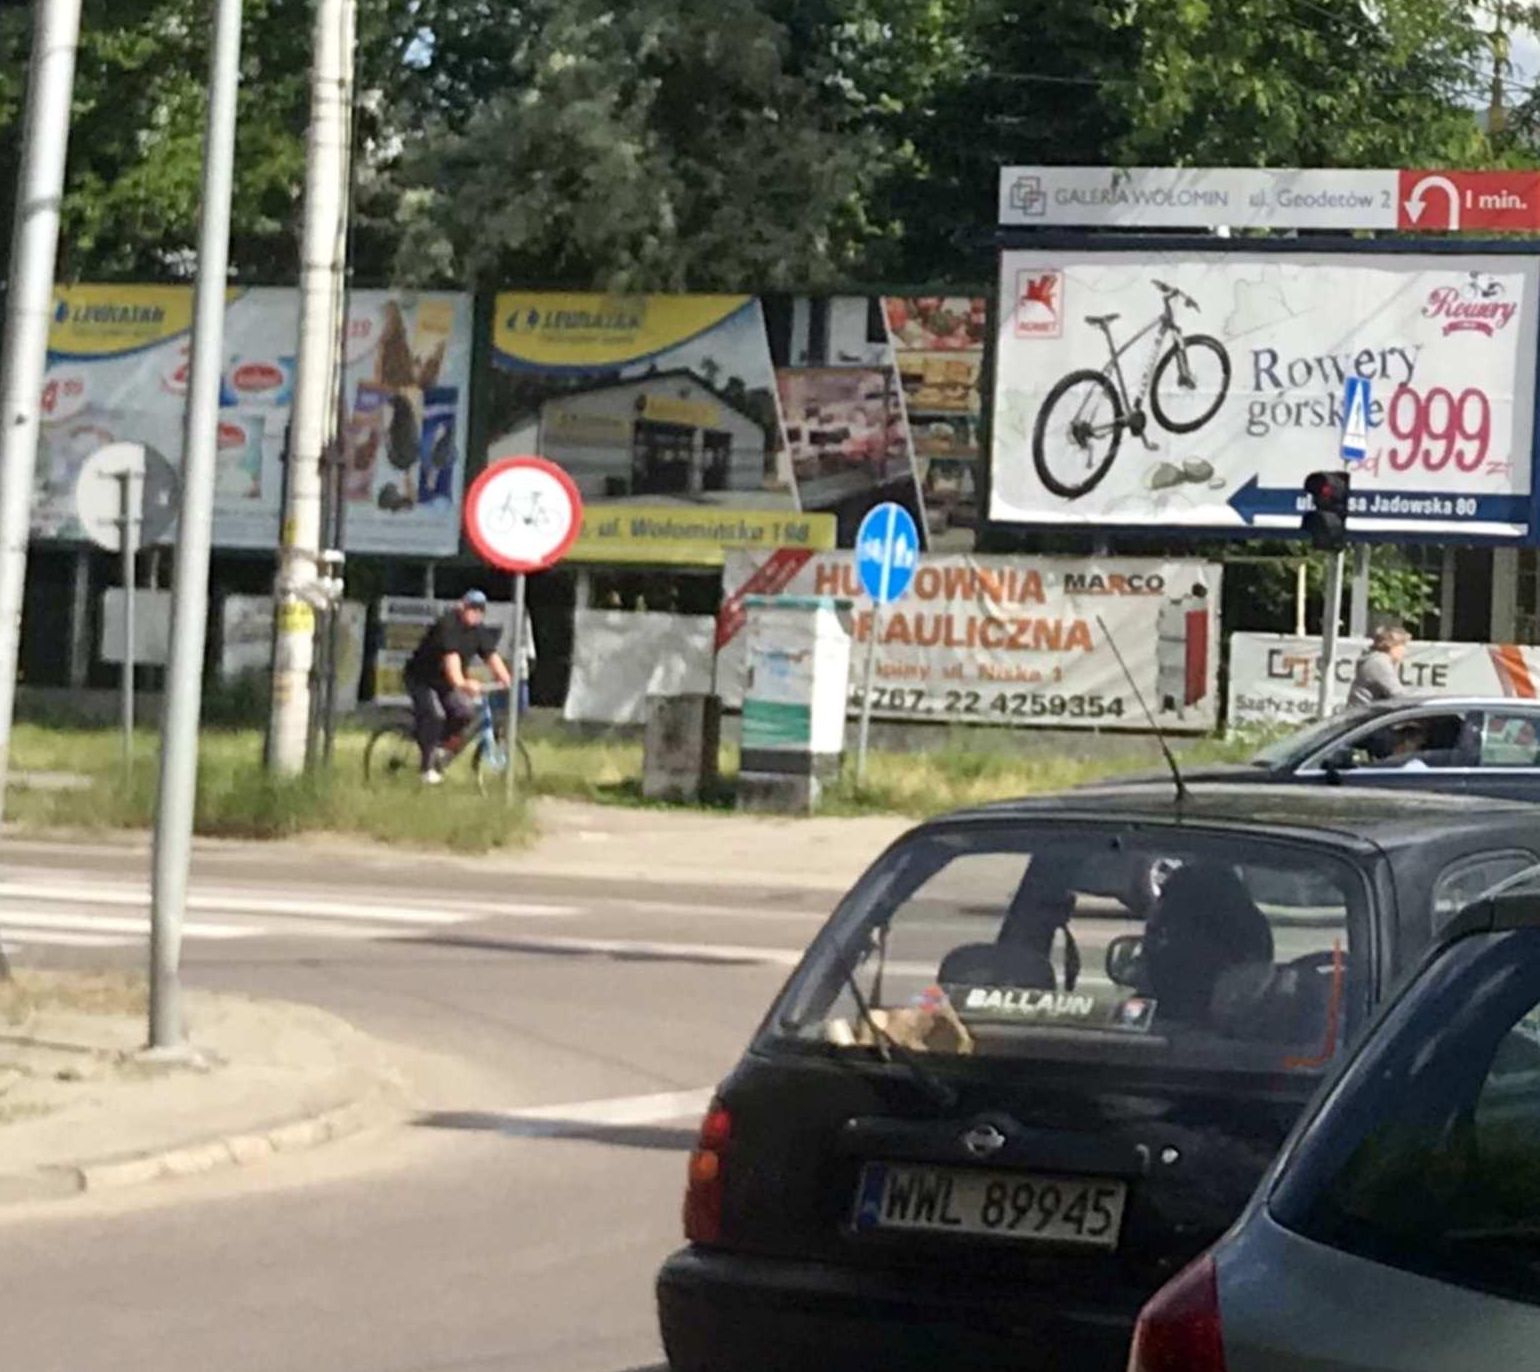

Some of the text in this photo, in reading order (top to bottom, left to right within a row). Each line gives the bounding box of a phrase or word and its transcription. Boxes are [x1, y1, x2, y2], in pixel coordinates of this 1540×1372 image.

[1277, 187, 1373, 209] Geodetów
[1380, 190, 1392, 209] 2
[1479, 188, 1528, 210] min.
[1249, 343, 1423, 392] Rowery
[1246, 391, 1385, 437] górske
[1388, 385, 1491, 473] 999
[1369, 493, 1453, 516] Jadowska
[1455, 497, 1478, 516] 80
[813, 562, 1047, 605] HUOWNIA
[1063, 572, 1165, 597] MARCO
[1314, 656, 1450, 688] SCLTE
[944, 690, 981, 714] 22
[990, 691, 1124, 719] 4259354
[885, 1171, 1117, 1236] WWL 89945
